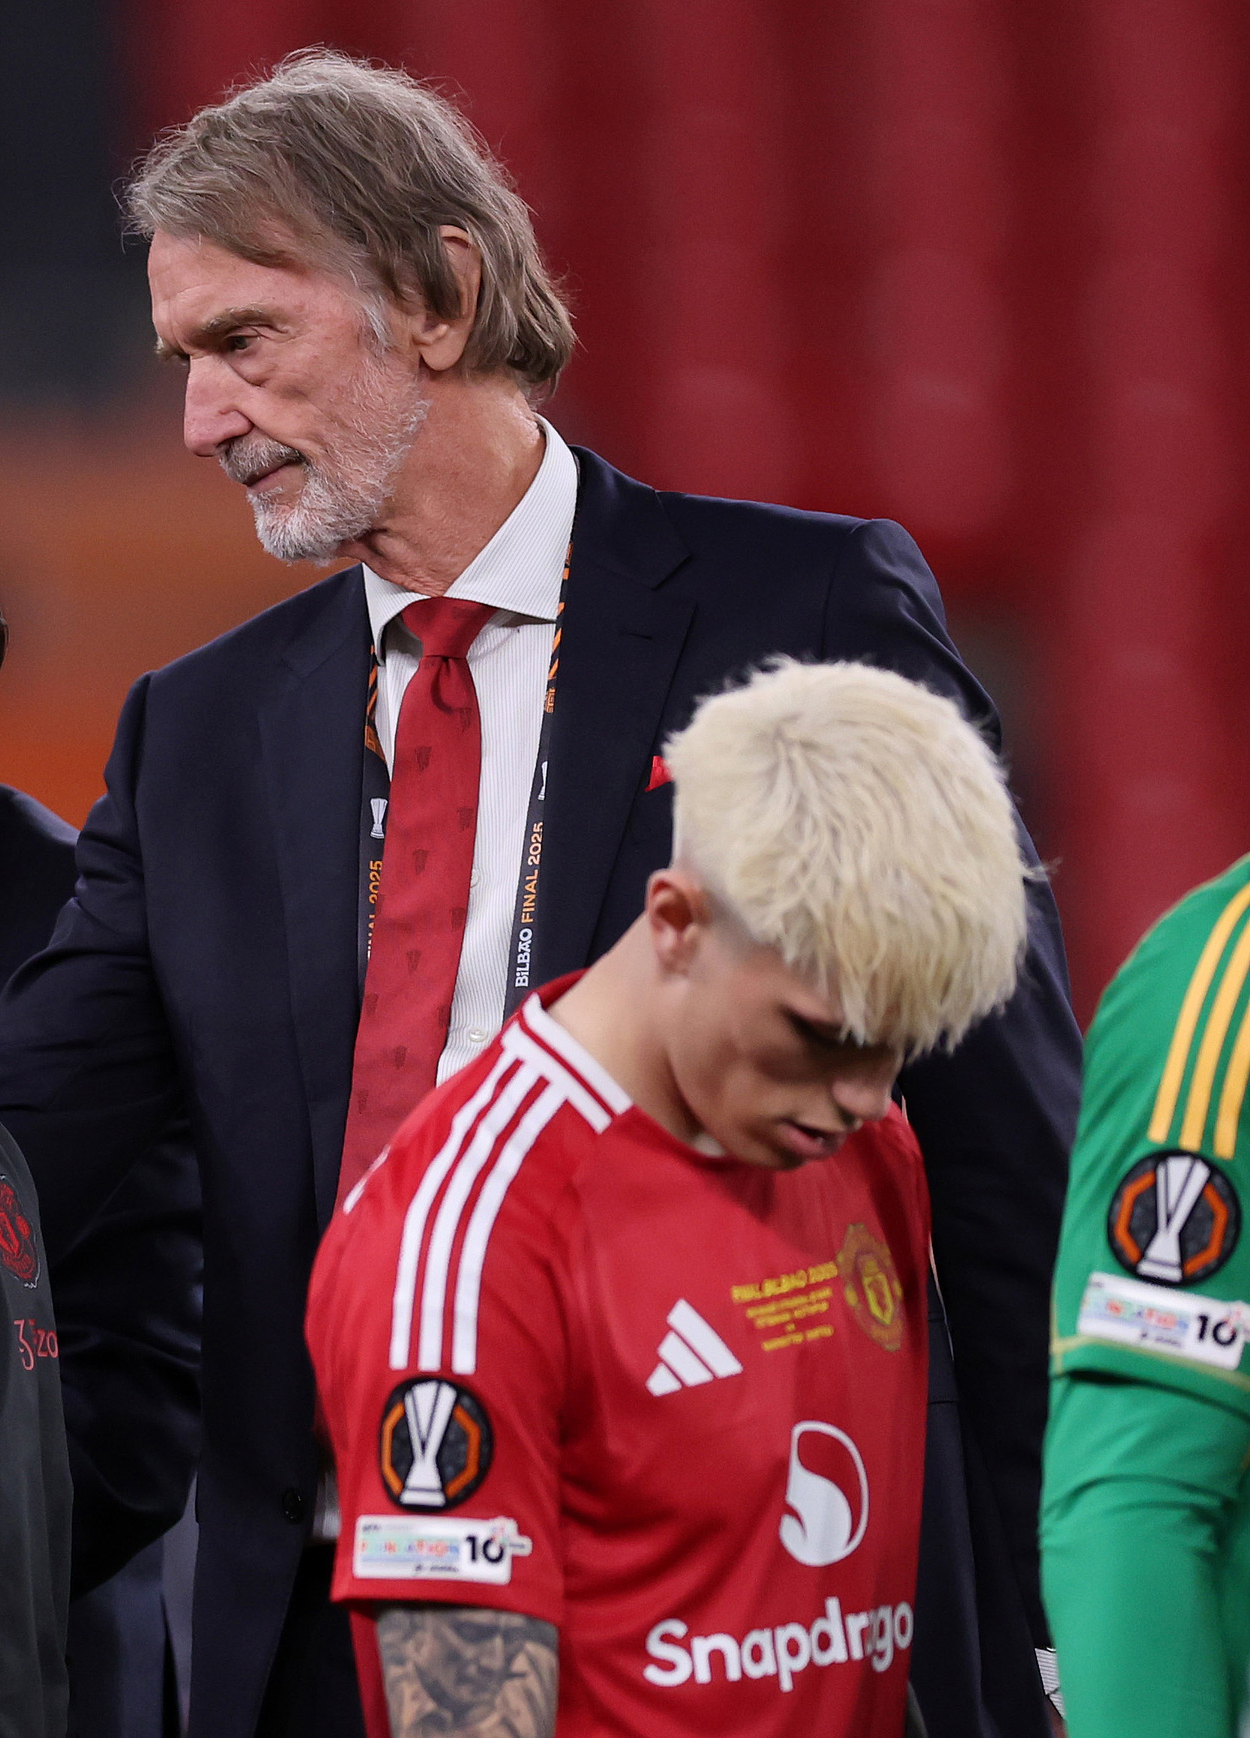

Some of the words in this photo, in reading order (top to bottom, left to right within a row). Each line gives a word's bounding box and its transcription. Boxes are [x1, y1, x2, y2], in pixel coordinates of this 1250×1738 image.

[528, 821, 544, 866] 2025
[521, 869, 539, 924] FINAL
[1197, 1314, 1238, 1346] 10
[465, 1534, 505, 1563] 10
